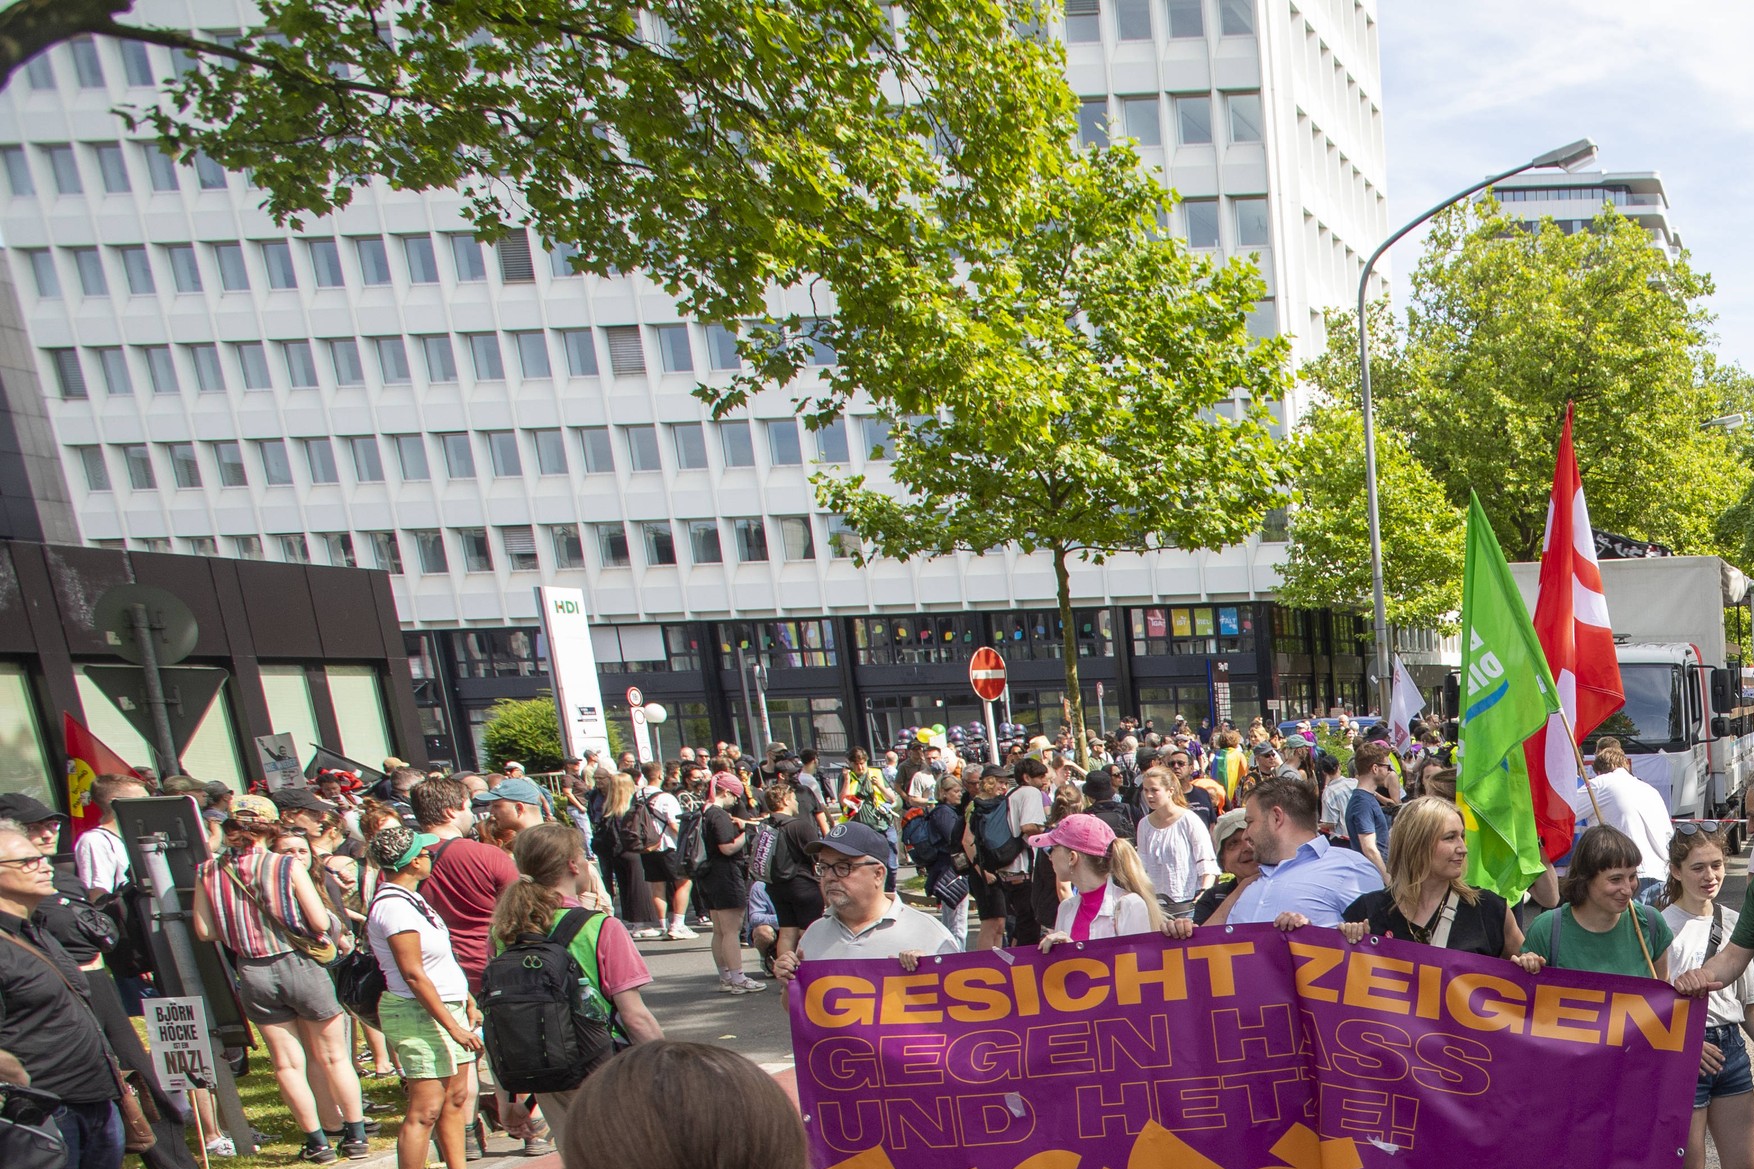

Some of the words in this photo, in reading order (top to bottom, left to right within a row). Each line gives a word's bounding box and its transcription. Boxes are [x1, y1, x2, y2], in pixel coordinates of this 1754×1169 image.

[554, 600, 579, 614] HDI
[804, 941, 1255, 1029] GESICHT
[1290, 942, 1690, 1052] ZEIGEN
[155, 1003, 195, 1022] BJÖRN
[159, 1022, 199, 1042] HÖCKE
[164, 1049, 205, 1075] NAZI
[808, 1013, 1173, 1092] GEGEN
[816, 1091, 1036, 1154] UND
